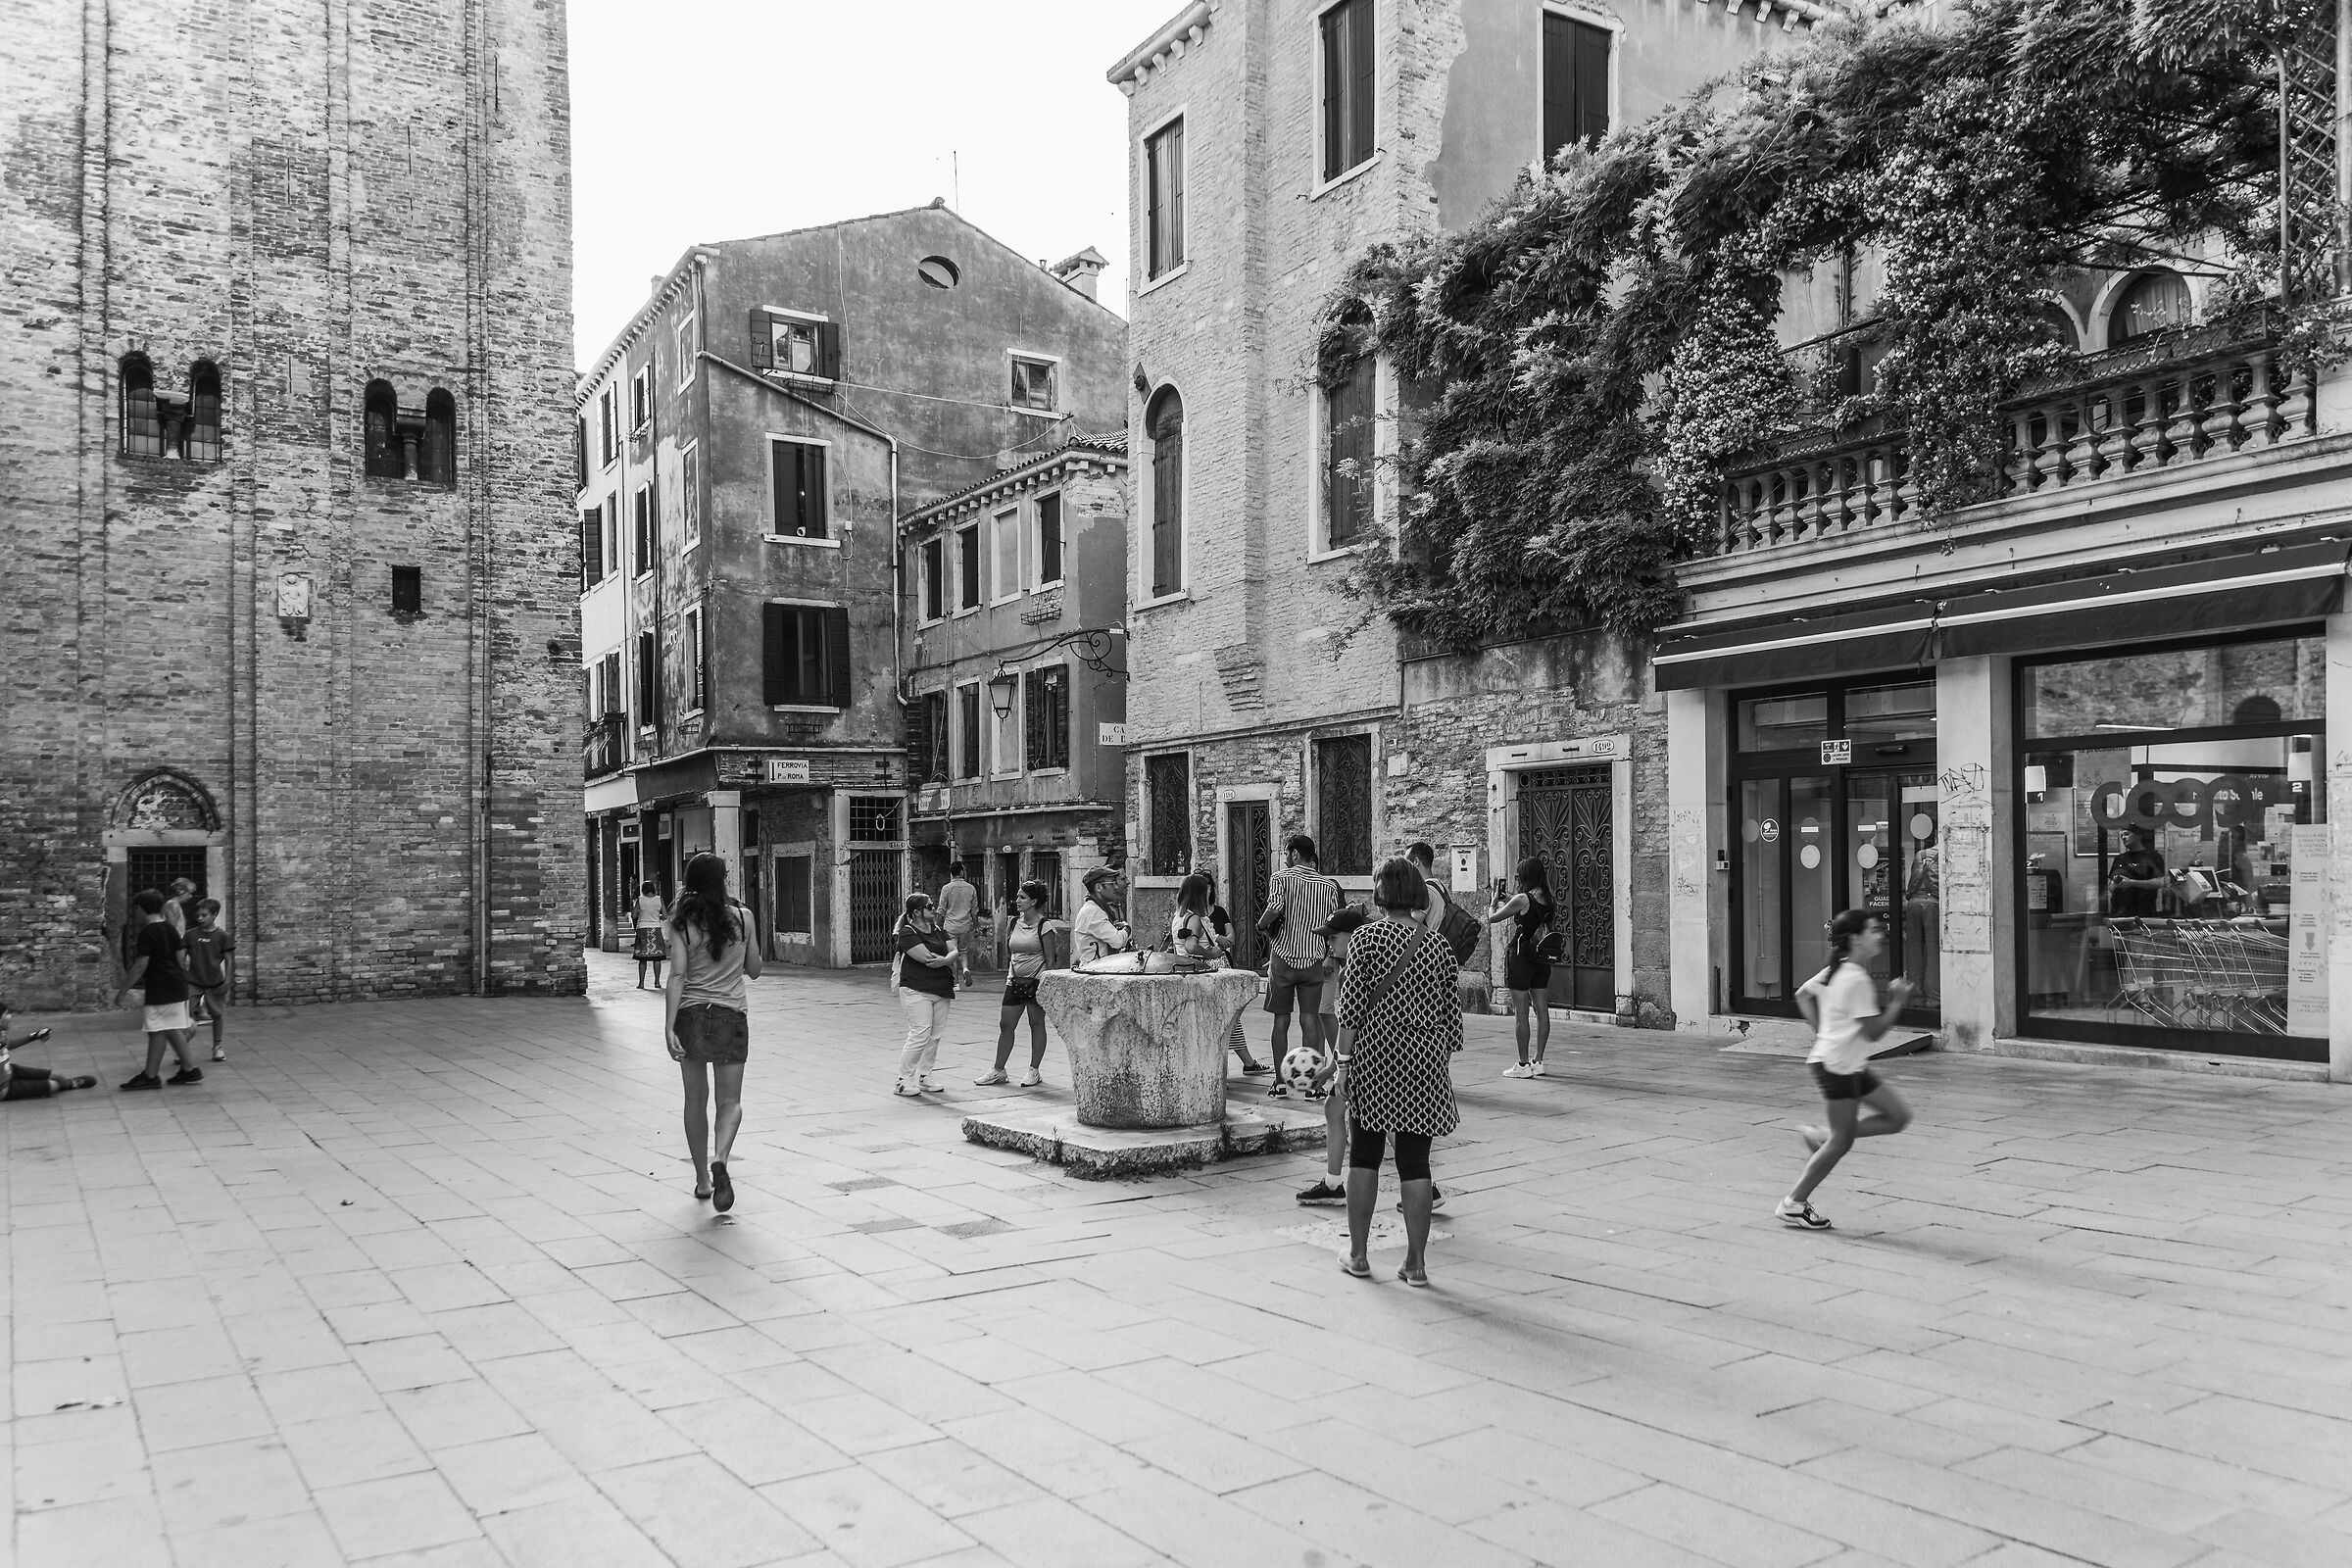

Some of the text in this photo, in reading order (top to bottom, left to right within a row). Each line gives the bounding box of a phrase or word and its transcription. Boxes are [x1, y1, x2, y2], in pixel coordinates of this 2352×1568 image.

[1594, 742, 1611, 751] 1492
[2291, 781, 2303, 793] 2
[2036, 792, 2044, 803] 1
